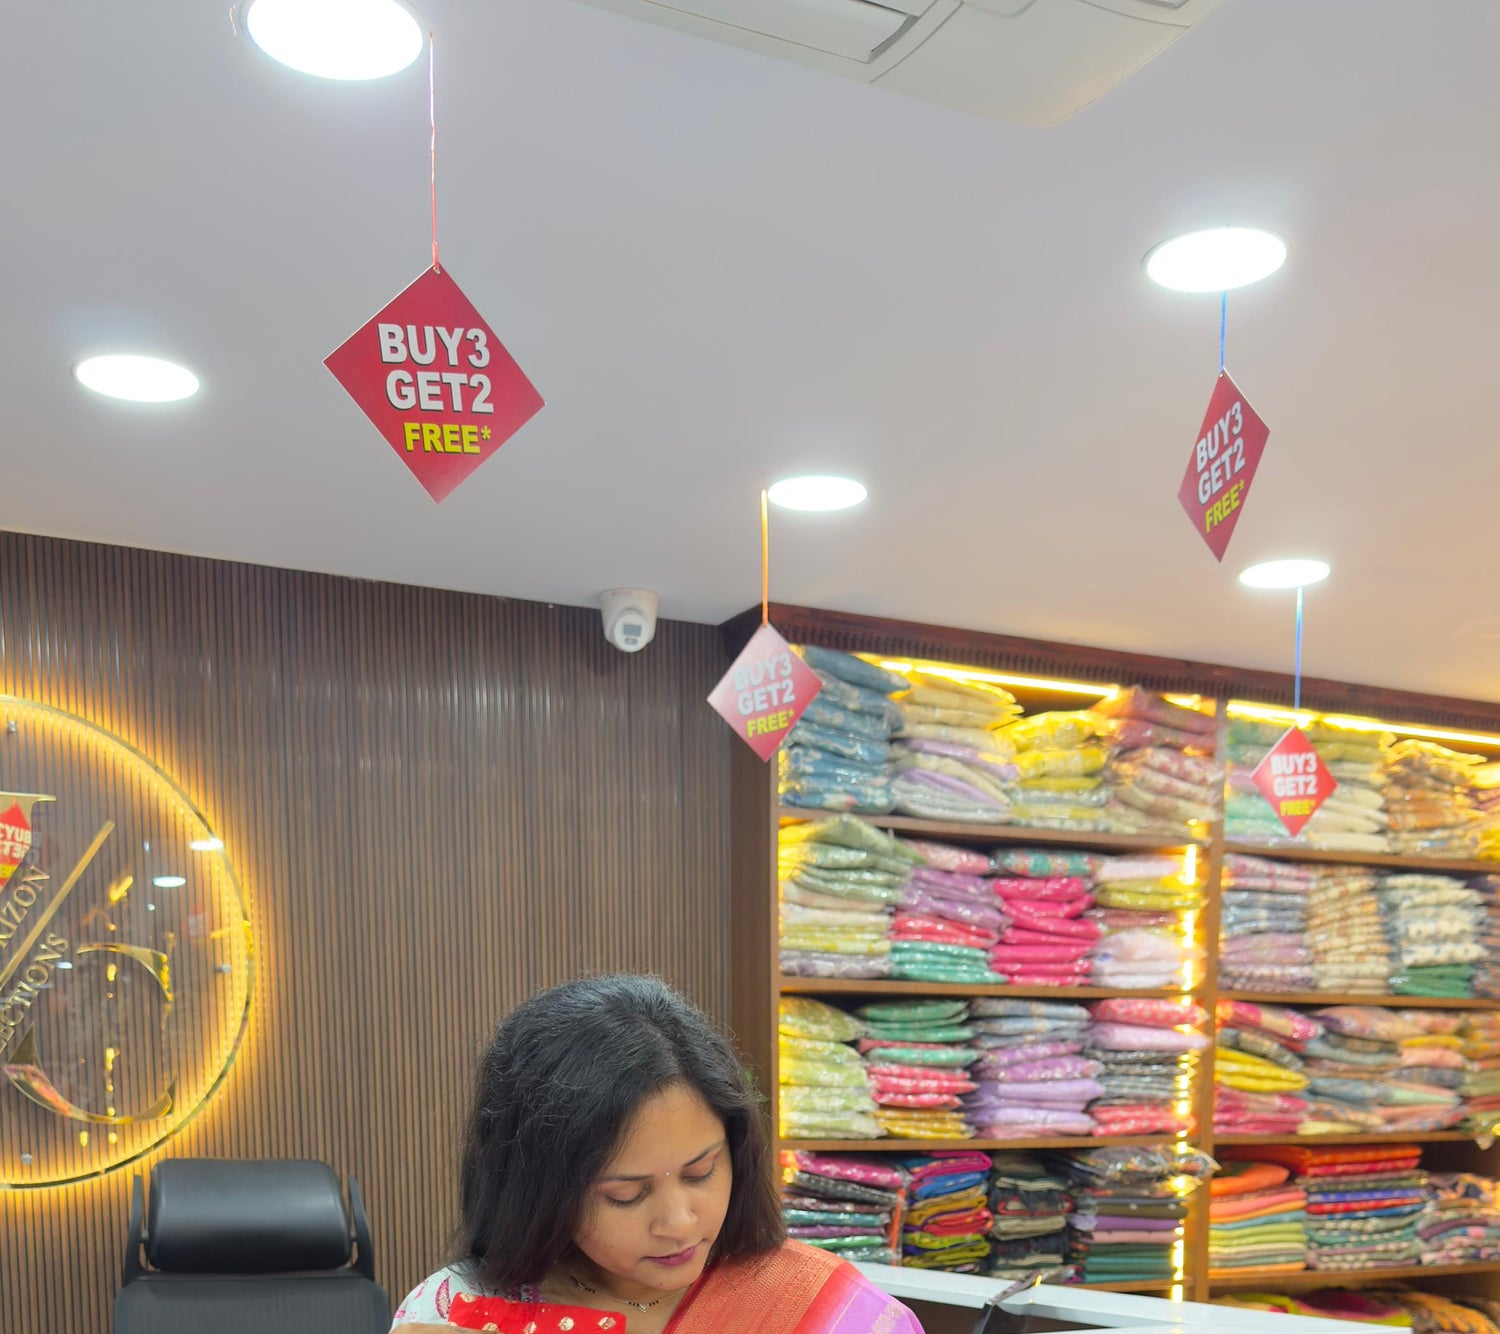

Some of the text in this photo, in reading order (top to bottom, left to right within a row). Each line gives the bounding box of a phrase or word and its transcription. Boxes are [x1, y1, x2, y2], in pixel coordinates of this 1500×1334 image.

[378, 323, 490, 368] BUY3
[386, 370, 494, 413] GET2
[1196, 401, 1243, 474] BUY3
[1197, 437, 1246, 505] GET2
[733, 652, 793, 692] BUY3
[737, 679, 796, 716] GET2
[1271, 752, 1318, 776] BUY3
[1273, 774, 1318, 797] GET2
